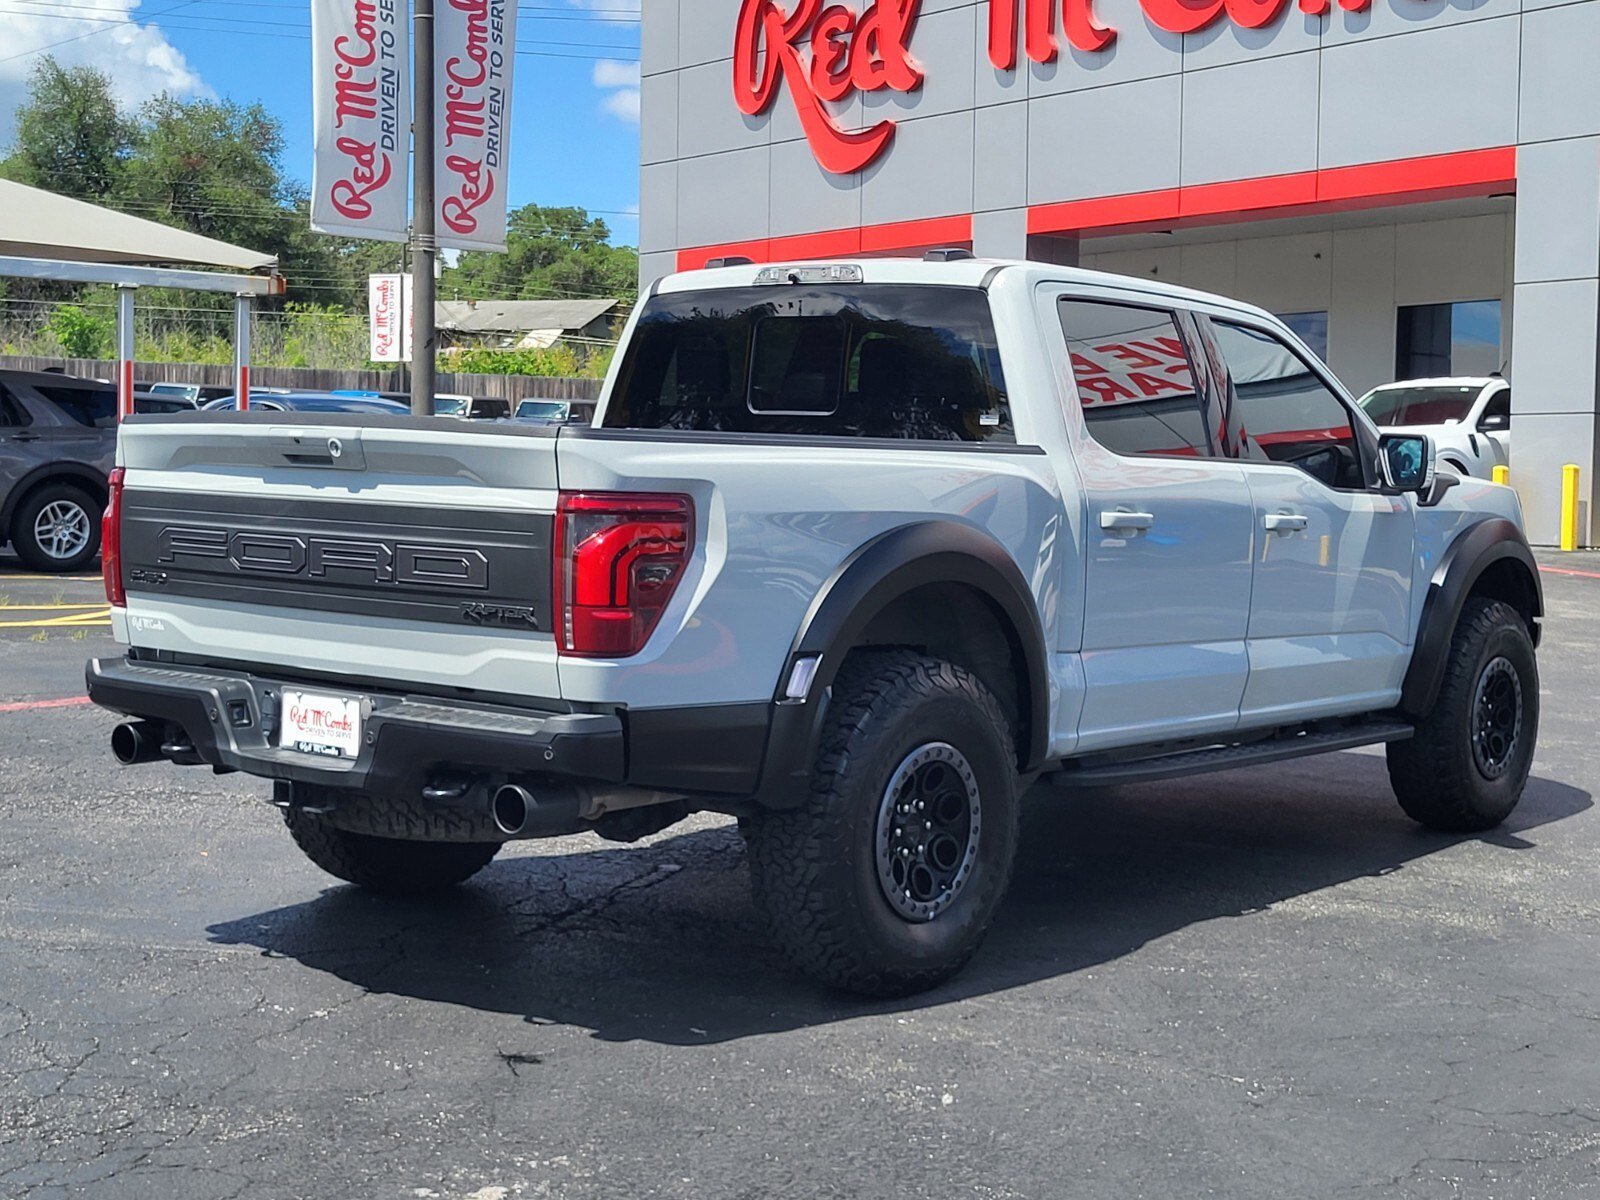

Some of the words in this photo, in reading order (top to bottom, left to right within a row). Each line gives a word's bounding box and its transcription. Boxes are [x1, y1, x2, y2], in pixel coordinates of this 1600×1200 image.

[380, 30, 395, 60] TO
[490, 51, 503, 79] TO
[381, 67, 395, 151] DRIVEN
[486, 85, 501, 168] DRIVEN
[330, 137, 391, 220] Red
[442, 155, 494, 234] Red
[375, 333, 393, 356] Red
[157, 526, 489, 590] FORD
[461, 601, 538, 624] RAPTOR
[289, 705, 308, 730] Red
[310, 709, 352, 731] McCombs
